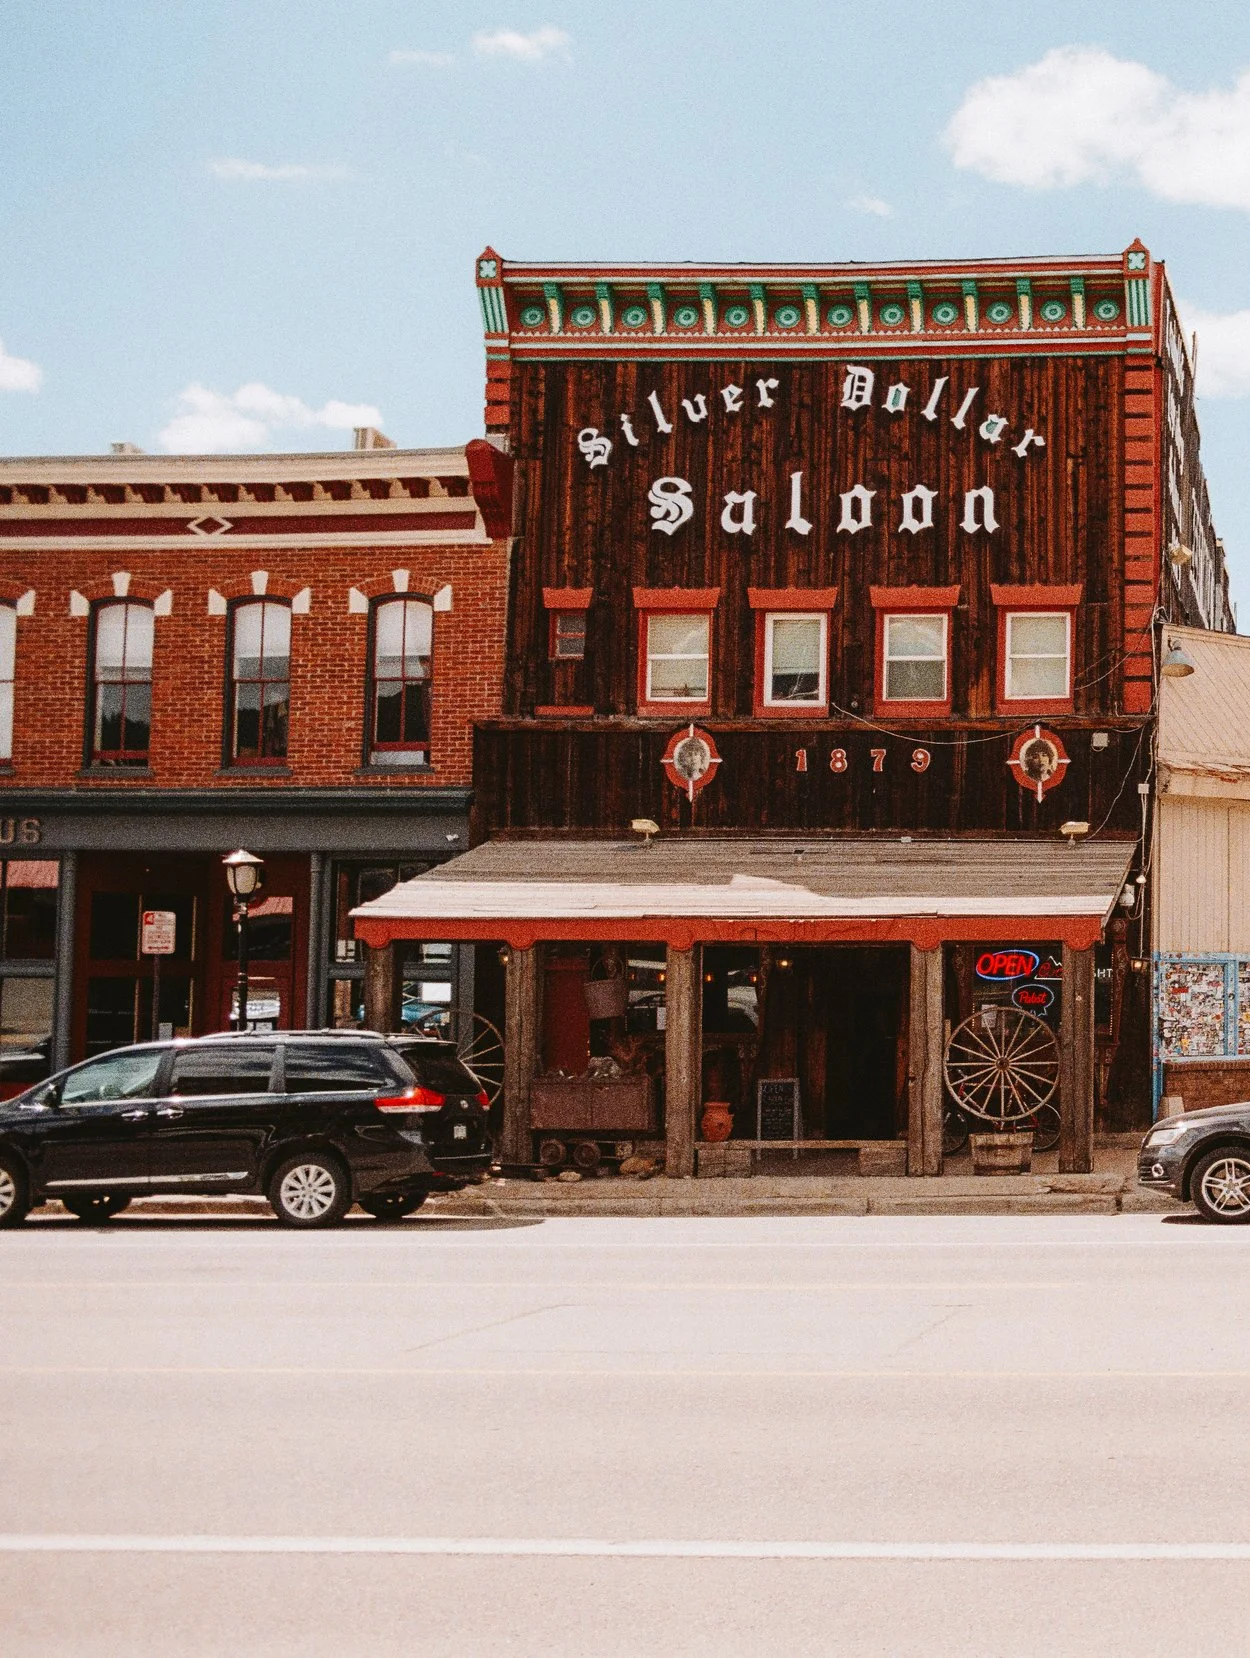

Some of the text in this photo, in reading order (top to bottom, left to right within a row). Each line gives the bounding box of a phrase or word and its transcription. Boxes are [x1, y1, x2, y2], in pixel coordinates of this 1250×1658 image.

[578, 365, 1046, 469] Silver Dollar
[647, 471, 1001, 535] Saloon
[795, 748, 931, 773] 1879
[976, 953, 1034, 976] OPEN
[1018, 990, 1047, 1004] Pabst
